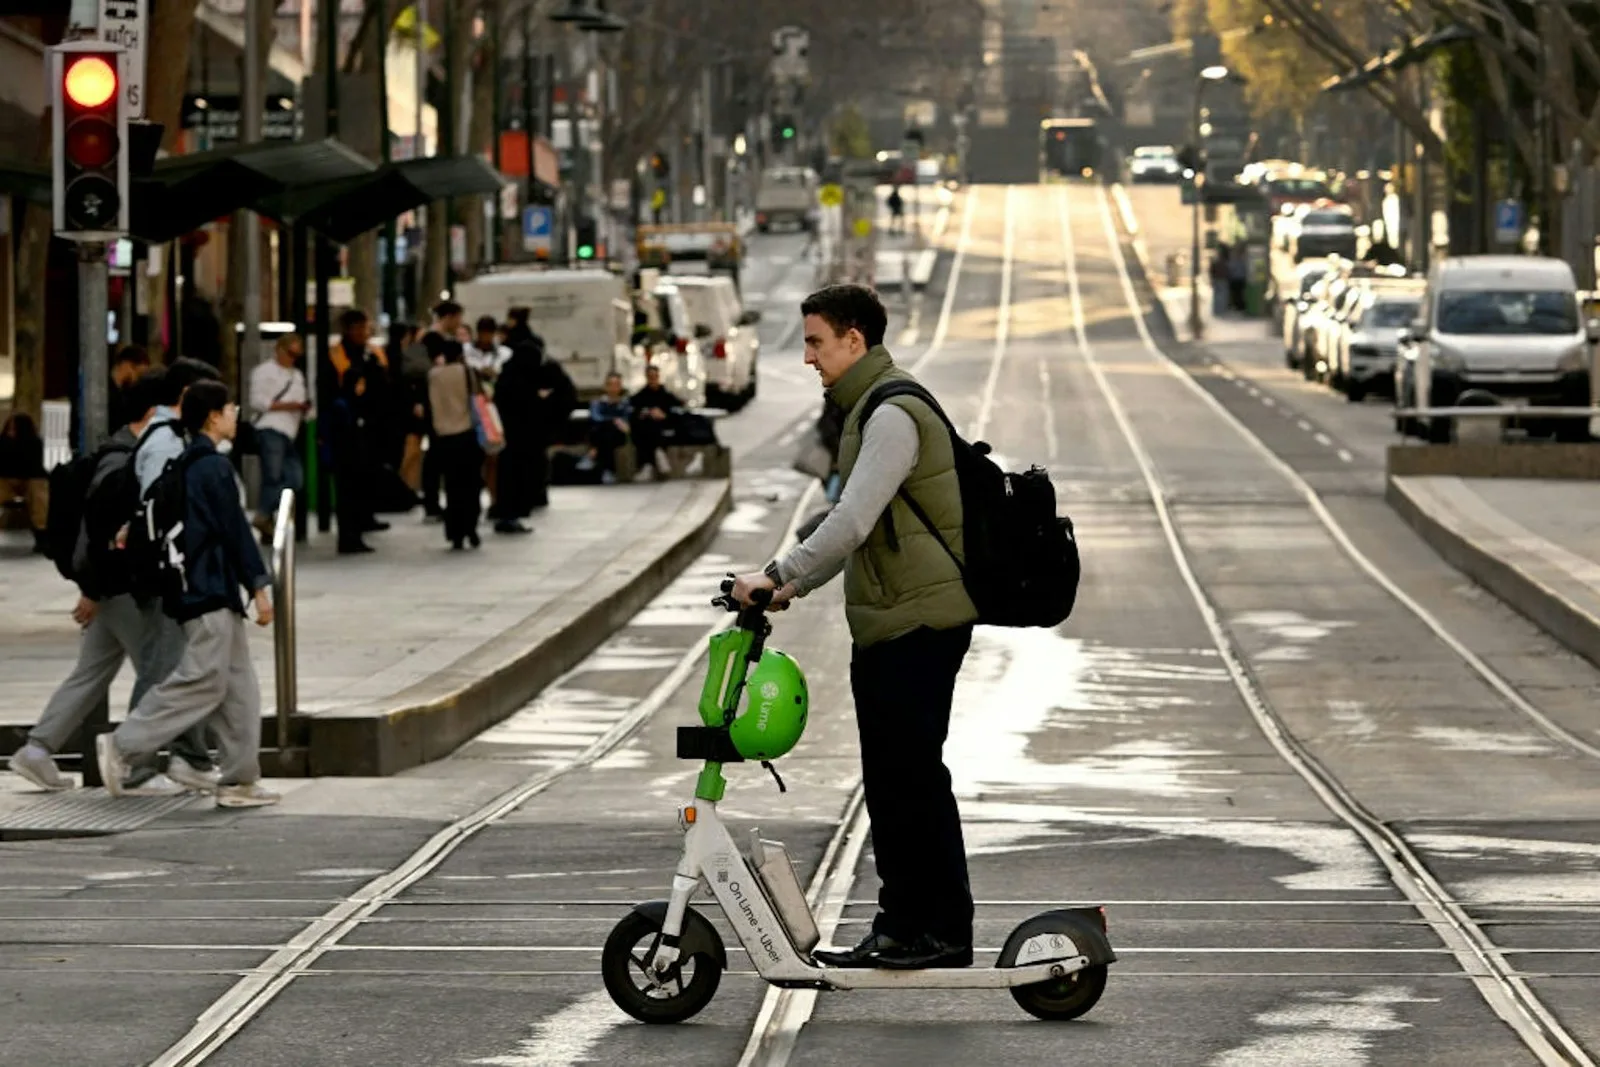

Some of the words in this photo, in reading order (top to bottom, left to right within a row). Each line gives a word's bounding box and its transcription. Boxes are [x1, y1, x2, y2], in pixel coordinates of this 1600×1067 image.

[105, 25, 138, 49] WATCH
[757, 701, 773, 731] Lime
[729, 881, 743, 901] On
[738, 898, 759, 927] Lime
[760, 933, 782, 963] Uber
